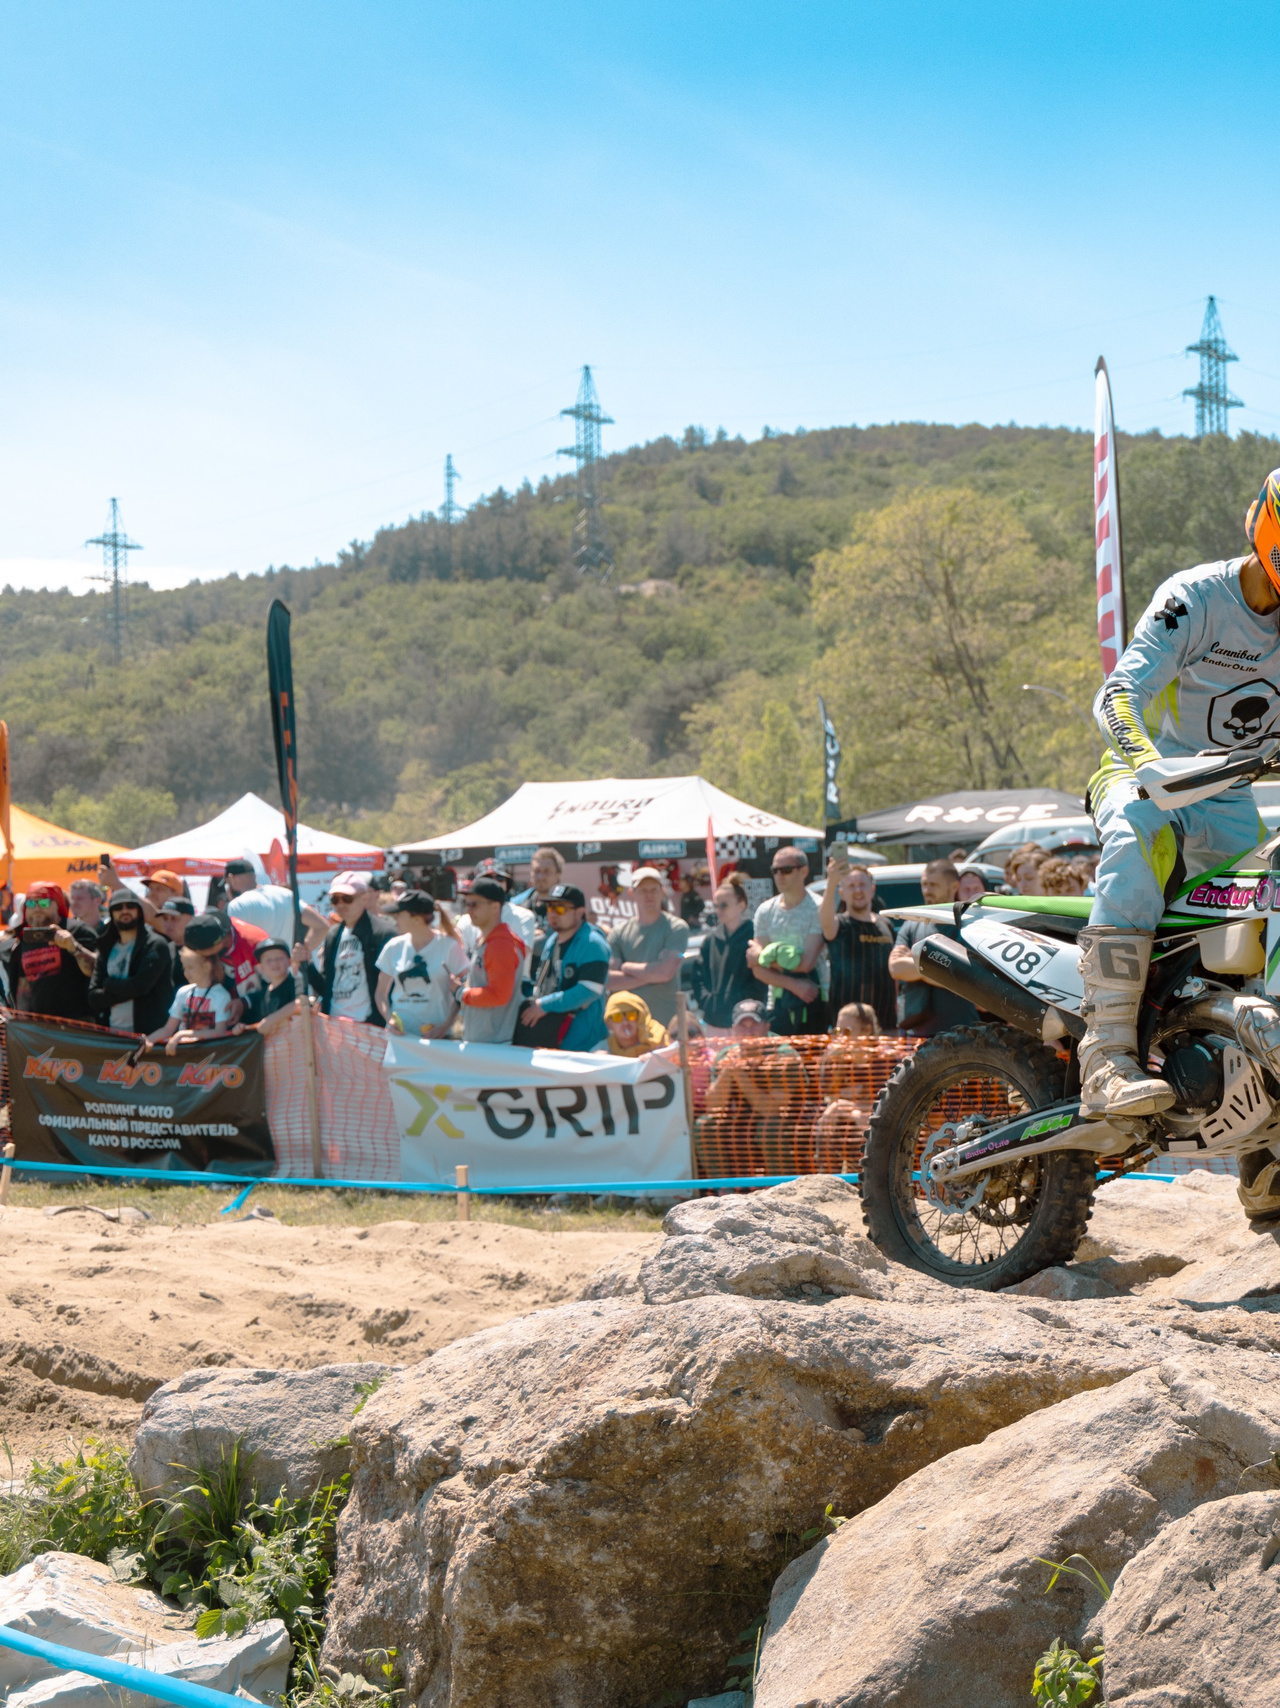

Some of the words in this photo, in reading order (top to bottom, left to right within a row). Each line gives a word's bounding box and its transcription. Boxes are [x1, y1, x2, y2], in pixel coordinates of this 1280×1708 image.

[1210, 641, 1262, 662] Cannibal
[67, 861, 98, 873] KTM
[928, 950, 952, 968] KTM
[987, 935, 1041, 975] 708
[23, 1047, 83, 1084] KAYO
[97, 1051, 162, 1089] KAYO
[176, 1052, 245, 1091] KAYO
[84, 1101, 137, 1116] РОЛЛИНГ
[138, 1105, 174, 1119] МОТО
[395, 1074, 675, 1140] X-GRIP
[38, 1113, 129, 1132] ОФИЦИАЛЬНЫЙ
[130, 1120, 239, 1137] ПРЕДСТАВИТЕЛЬ
[1020, 1113, 1074, 1141] KTM
[88, 1134, 120, 1147] KAYO
[121, 1136, 130, 1148] В
[130, 1137, 182, 1149] РОССИИ
